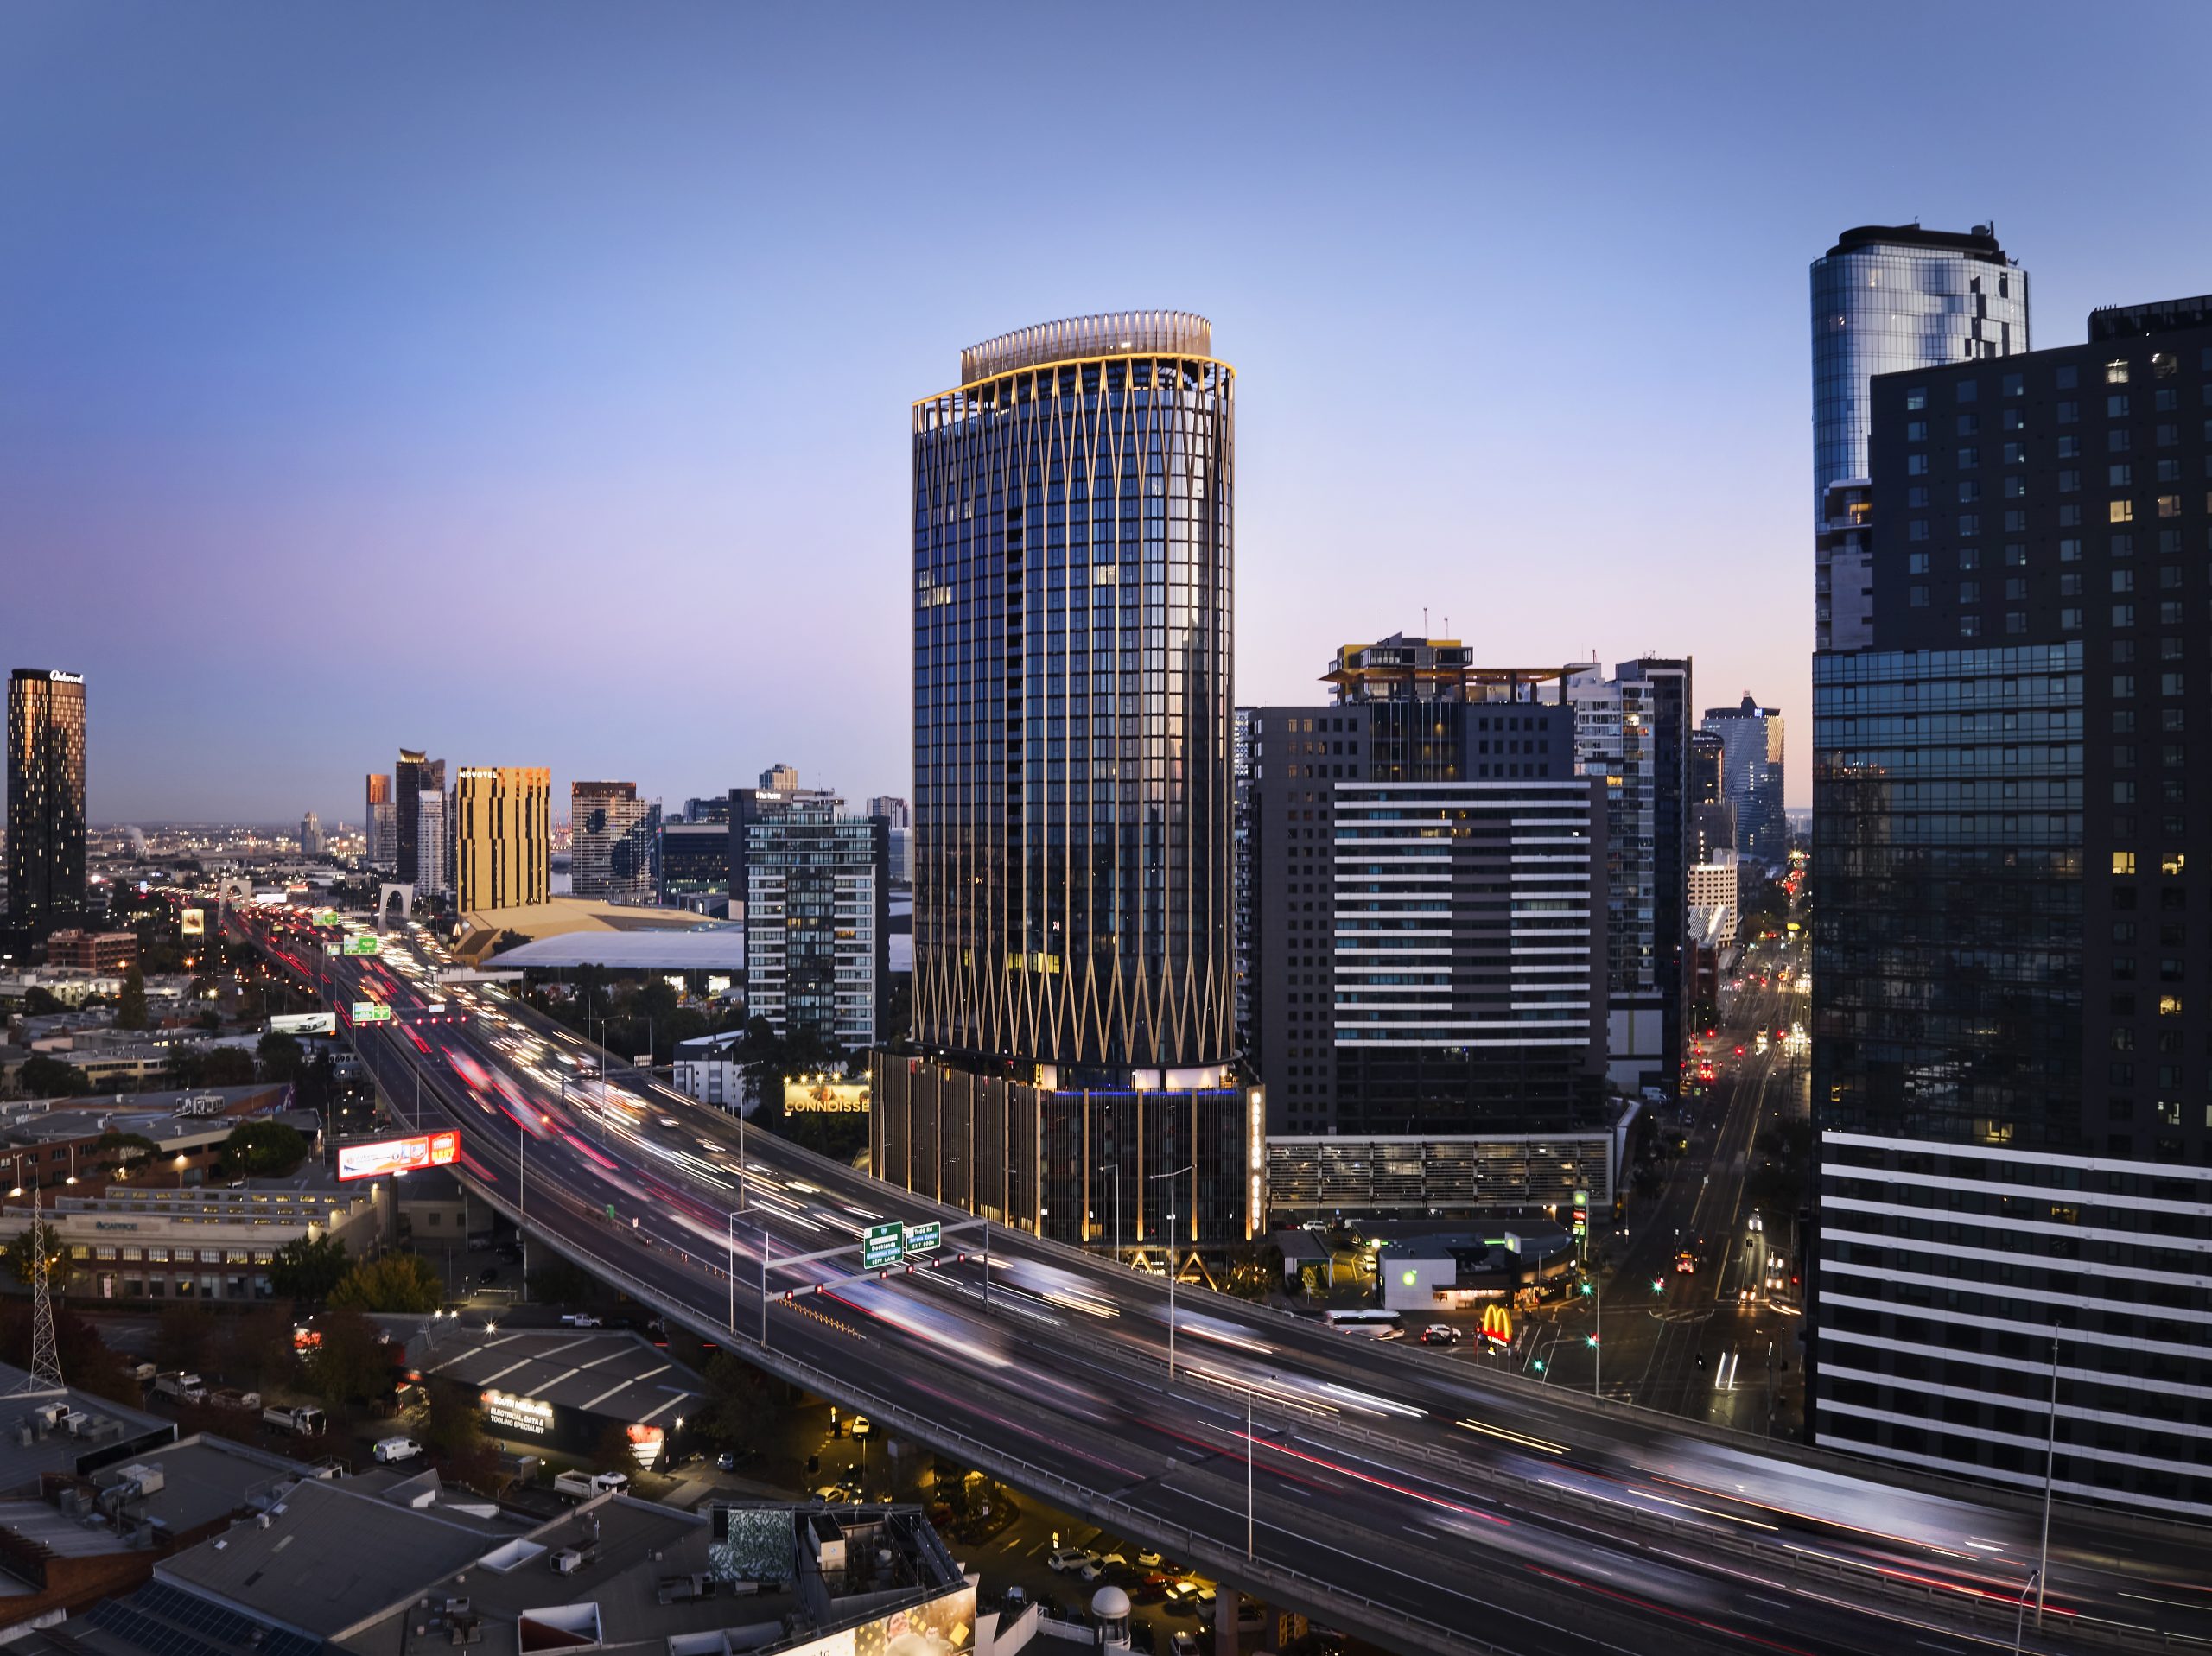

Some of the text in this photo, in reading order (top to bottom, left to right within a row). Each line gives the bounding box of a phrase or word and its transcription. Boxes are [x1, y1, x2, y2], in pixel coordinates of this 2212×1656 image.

[490, 1415, 544, 1434] TOOLING SPECIALIST
[524, 1416, 539, 1426] DATA
